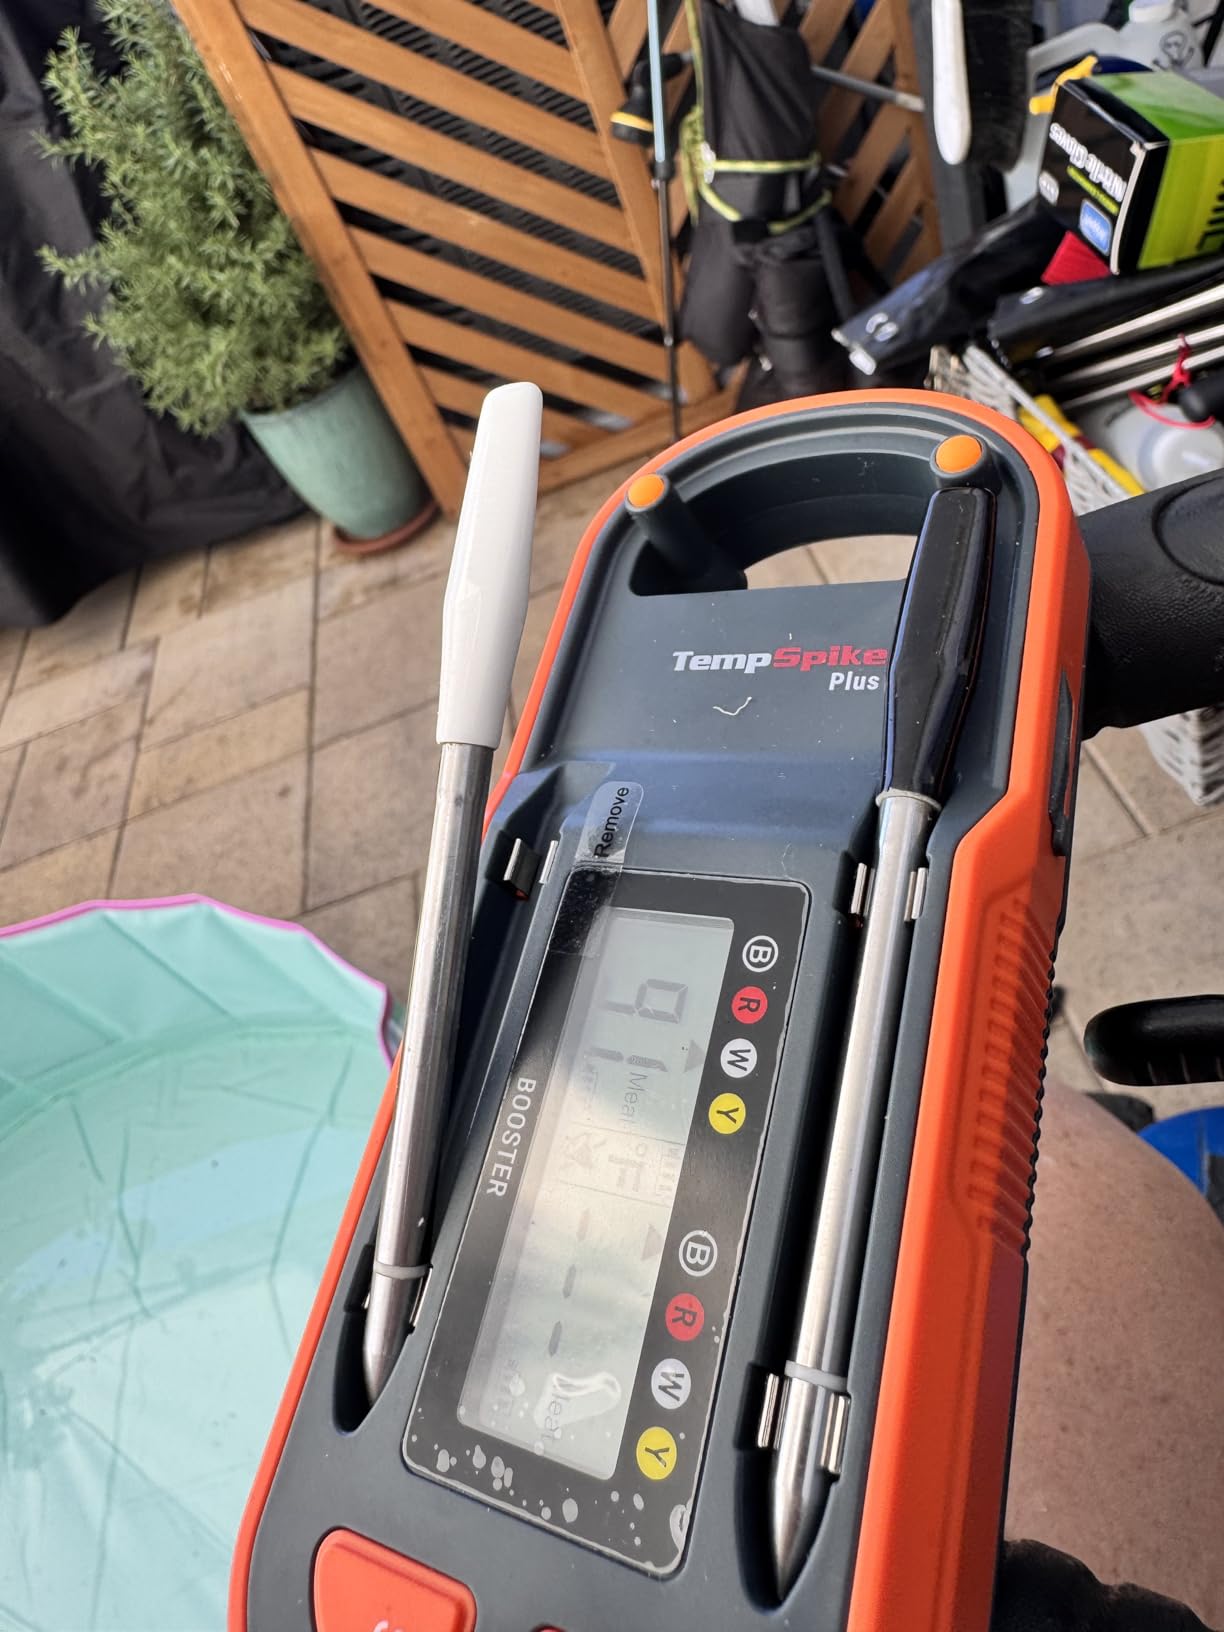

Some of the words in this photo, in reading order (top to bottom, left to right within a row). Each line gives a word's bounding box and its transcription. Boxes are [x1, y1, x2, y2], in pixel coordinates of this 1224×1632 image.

[672, 646, 888, 674] TempSpike
[828, 672, 880, 691] Plus
[593, 786, 630, 858] Remove
[486, 1076, 537, 1197] BOOSTER
